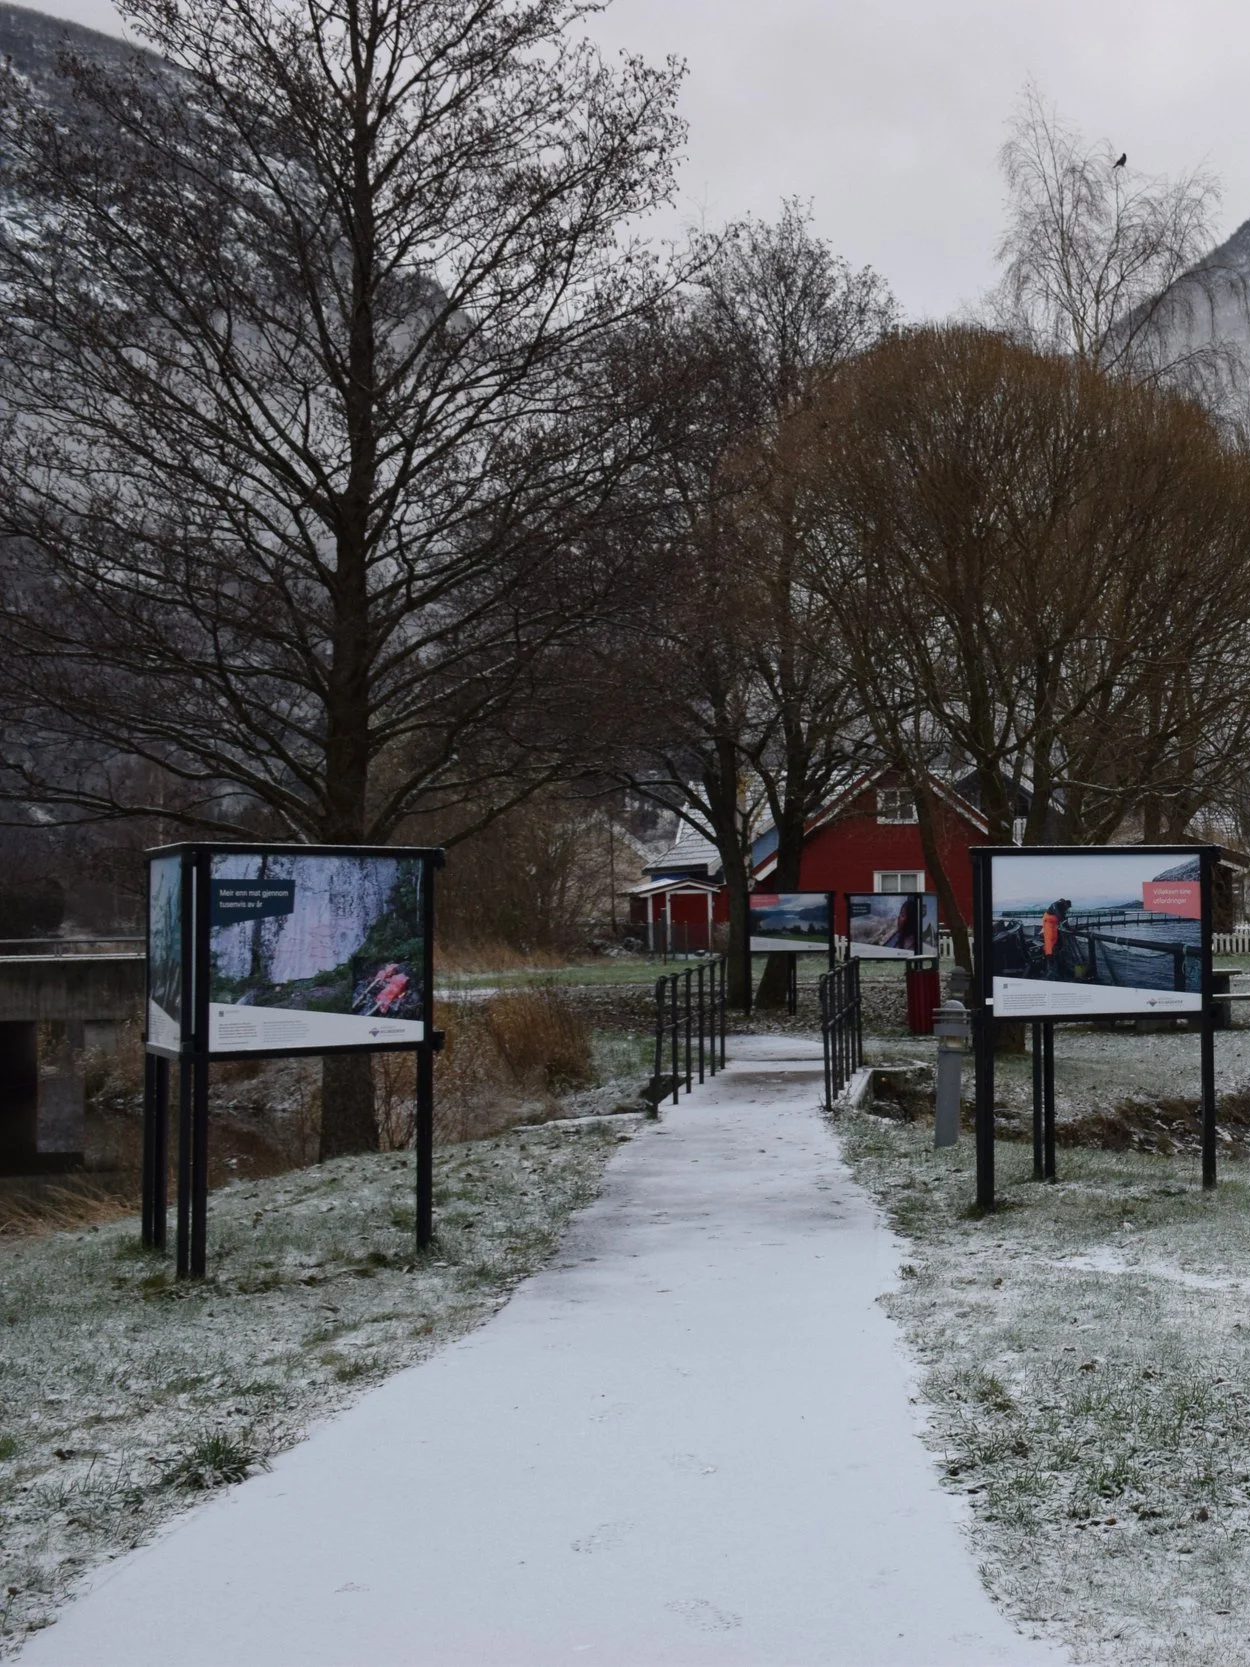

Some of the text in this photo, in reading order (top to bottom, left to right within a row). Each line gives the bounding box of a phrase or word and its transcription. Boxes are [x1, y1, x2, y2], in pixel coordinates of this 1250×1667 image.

[219, 889, 234, 897] Meir
[248, 889, 261, 897] mat
[261, 889, 289, 898] gjennom
